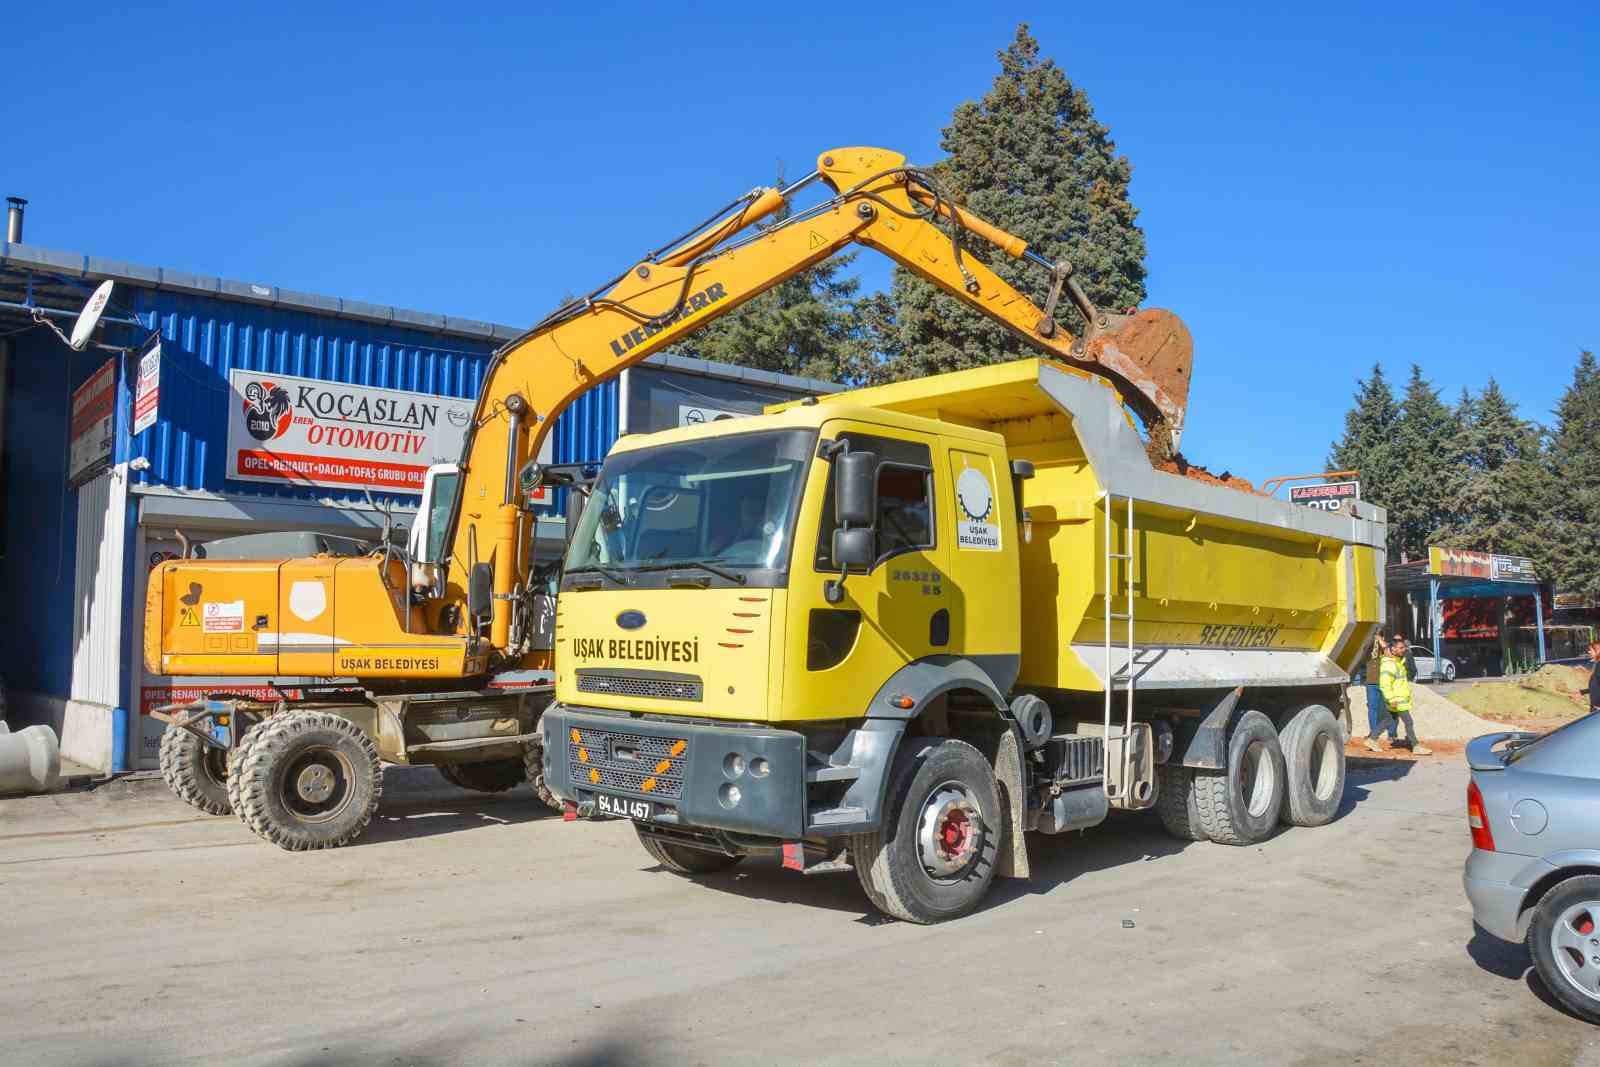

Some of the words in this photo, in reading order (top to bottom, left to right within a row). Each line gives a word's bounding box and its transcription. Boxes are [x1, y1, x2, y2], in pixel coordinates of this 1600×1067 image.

[296, 386, 439, 429] KOÇASLAN
[251, 420, 270, 432] 2010
[307, 424, 427, 454] OTOMOTİV
[244, 456, 269, 469] OPEL
[273, 459, 314, 474] RENAULT
[319, 464, 345, 475] DACIA
[350, 466, 376, 480] TOFAŞ
[378, 468, 405, 481] GRUBU
[960, 535, 998, 546] BELEDİYESİ
[969, 526, 988, 535] UŞAK
[573, 637, 605, 663] UŞAK
[608, 634, 700, 663] BELEDİYESİ
[341, 657, 371, 671] UŞAK
[374, 655, 440, 671] BELEDİYESİ
[599, 795, 611, 811] 64
[613, 798, 627, 815] AJ
[630, 802, 649, 818] 467
